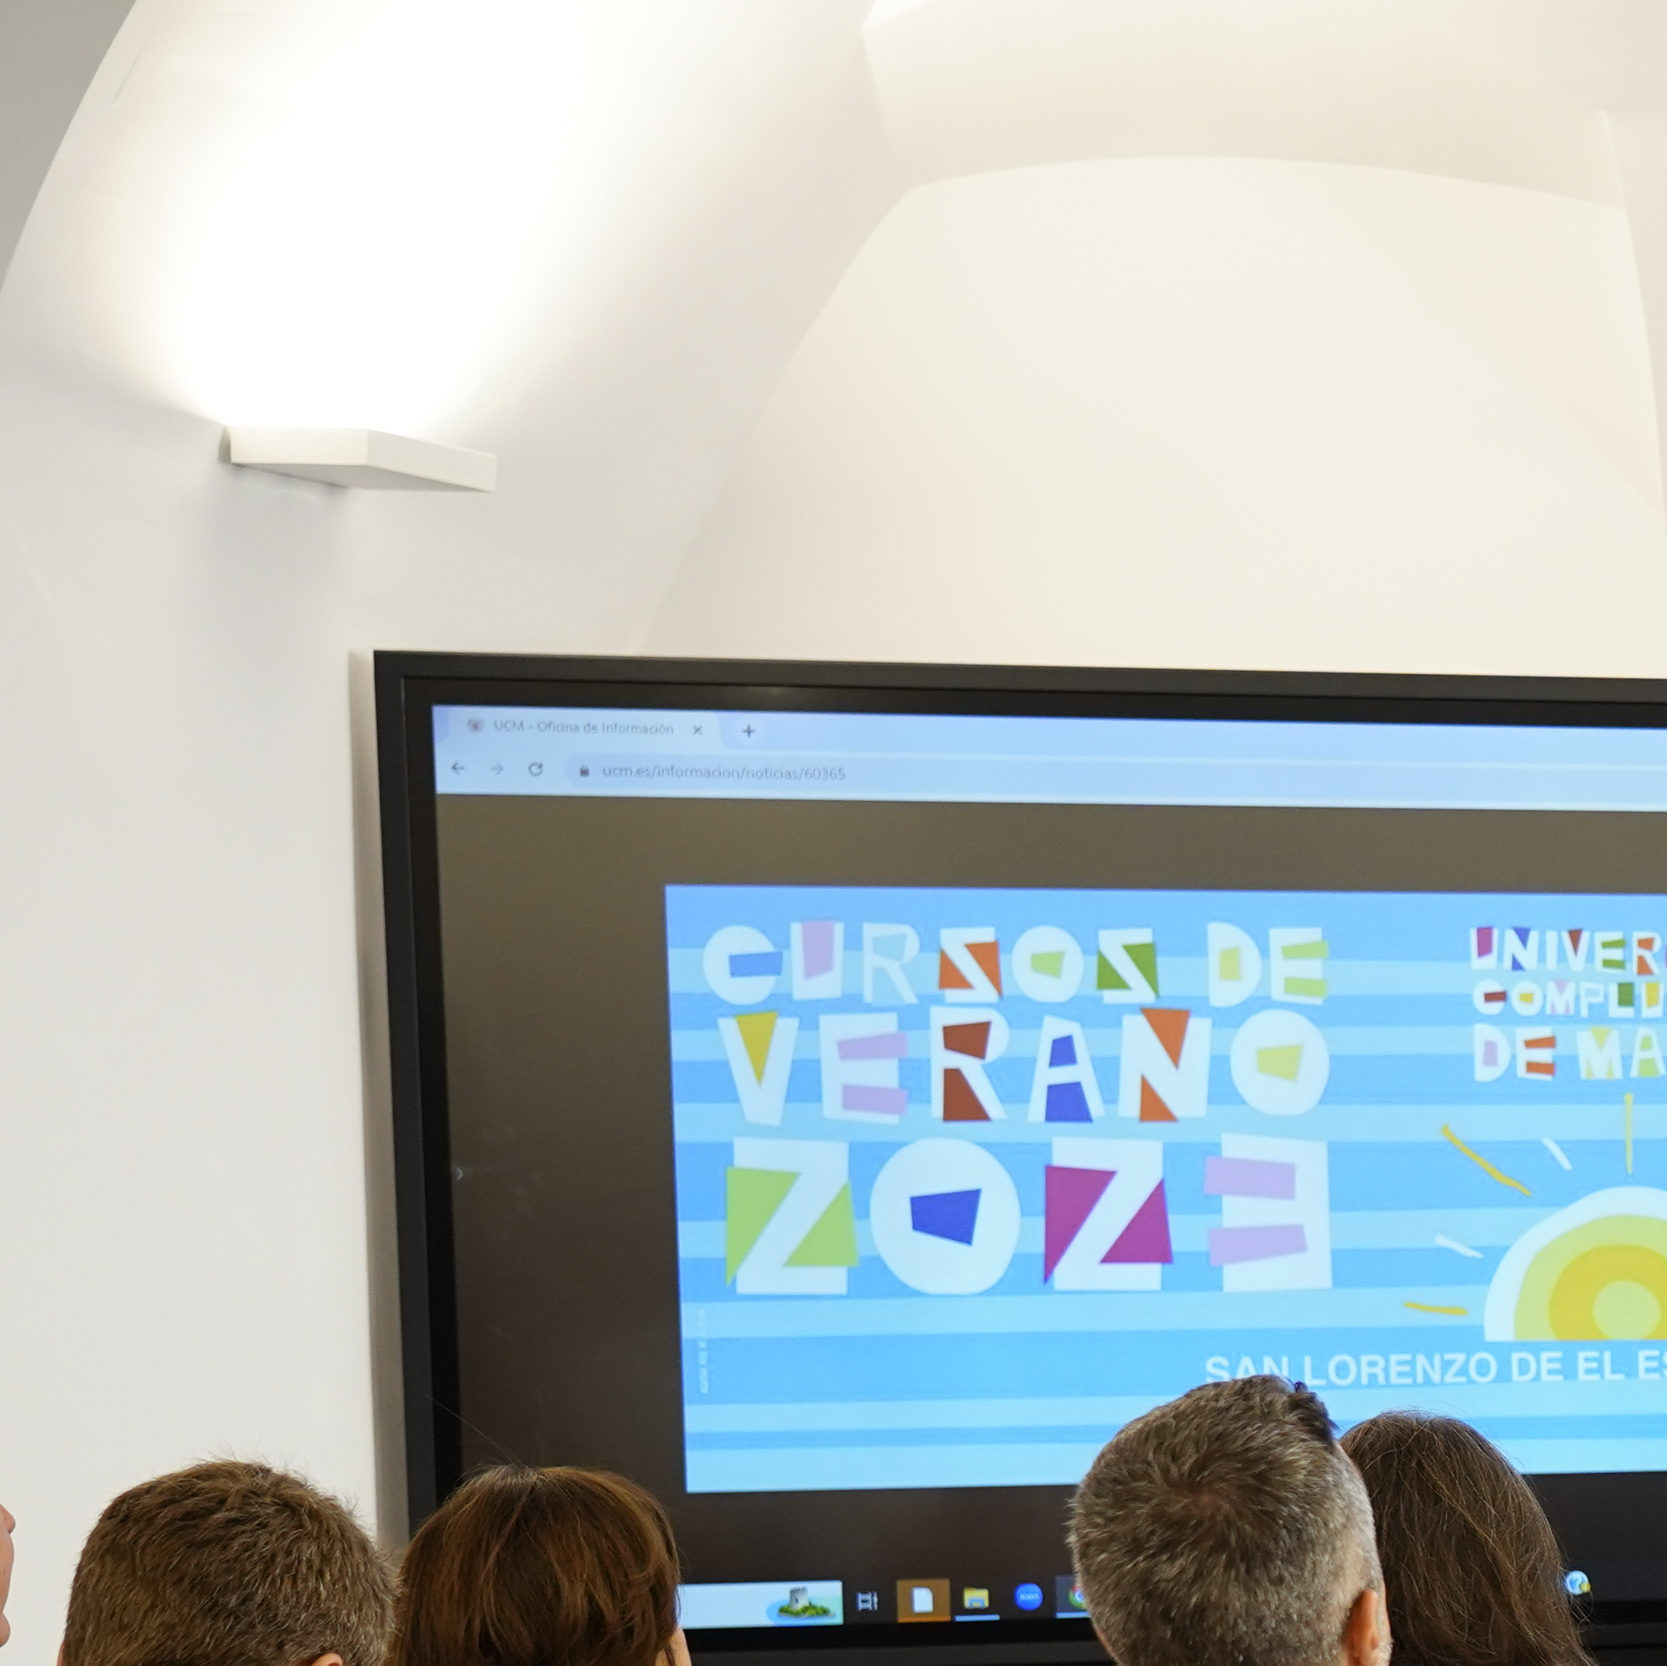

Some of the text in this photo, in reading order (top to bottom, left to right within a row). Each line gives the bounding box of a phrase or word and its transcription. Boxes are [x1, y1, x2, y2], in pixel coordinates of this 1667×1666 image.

[493, 720, 525, 732] UCM
[536, 720, 580, 734] Oficina
[583, 721, 599, 734] de
[602, 721, 675, 736] Información
[602, 764, 846, 782] ucm.es/informacion/noticias/60365
[703, 920, 1330, 1008] CURSOS DE
[717, 1006, 1331, 1127] VERANO
[1474, 1022, 1557, 1083] DE
[1205, 1355, 1290, 1384] SAN
[1303, 1352, 1498, 1387] LORENZO
[1511, 1351, 1563, 1383] DE
[1577, 1351, 1626, 1382] EL
